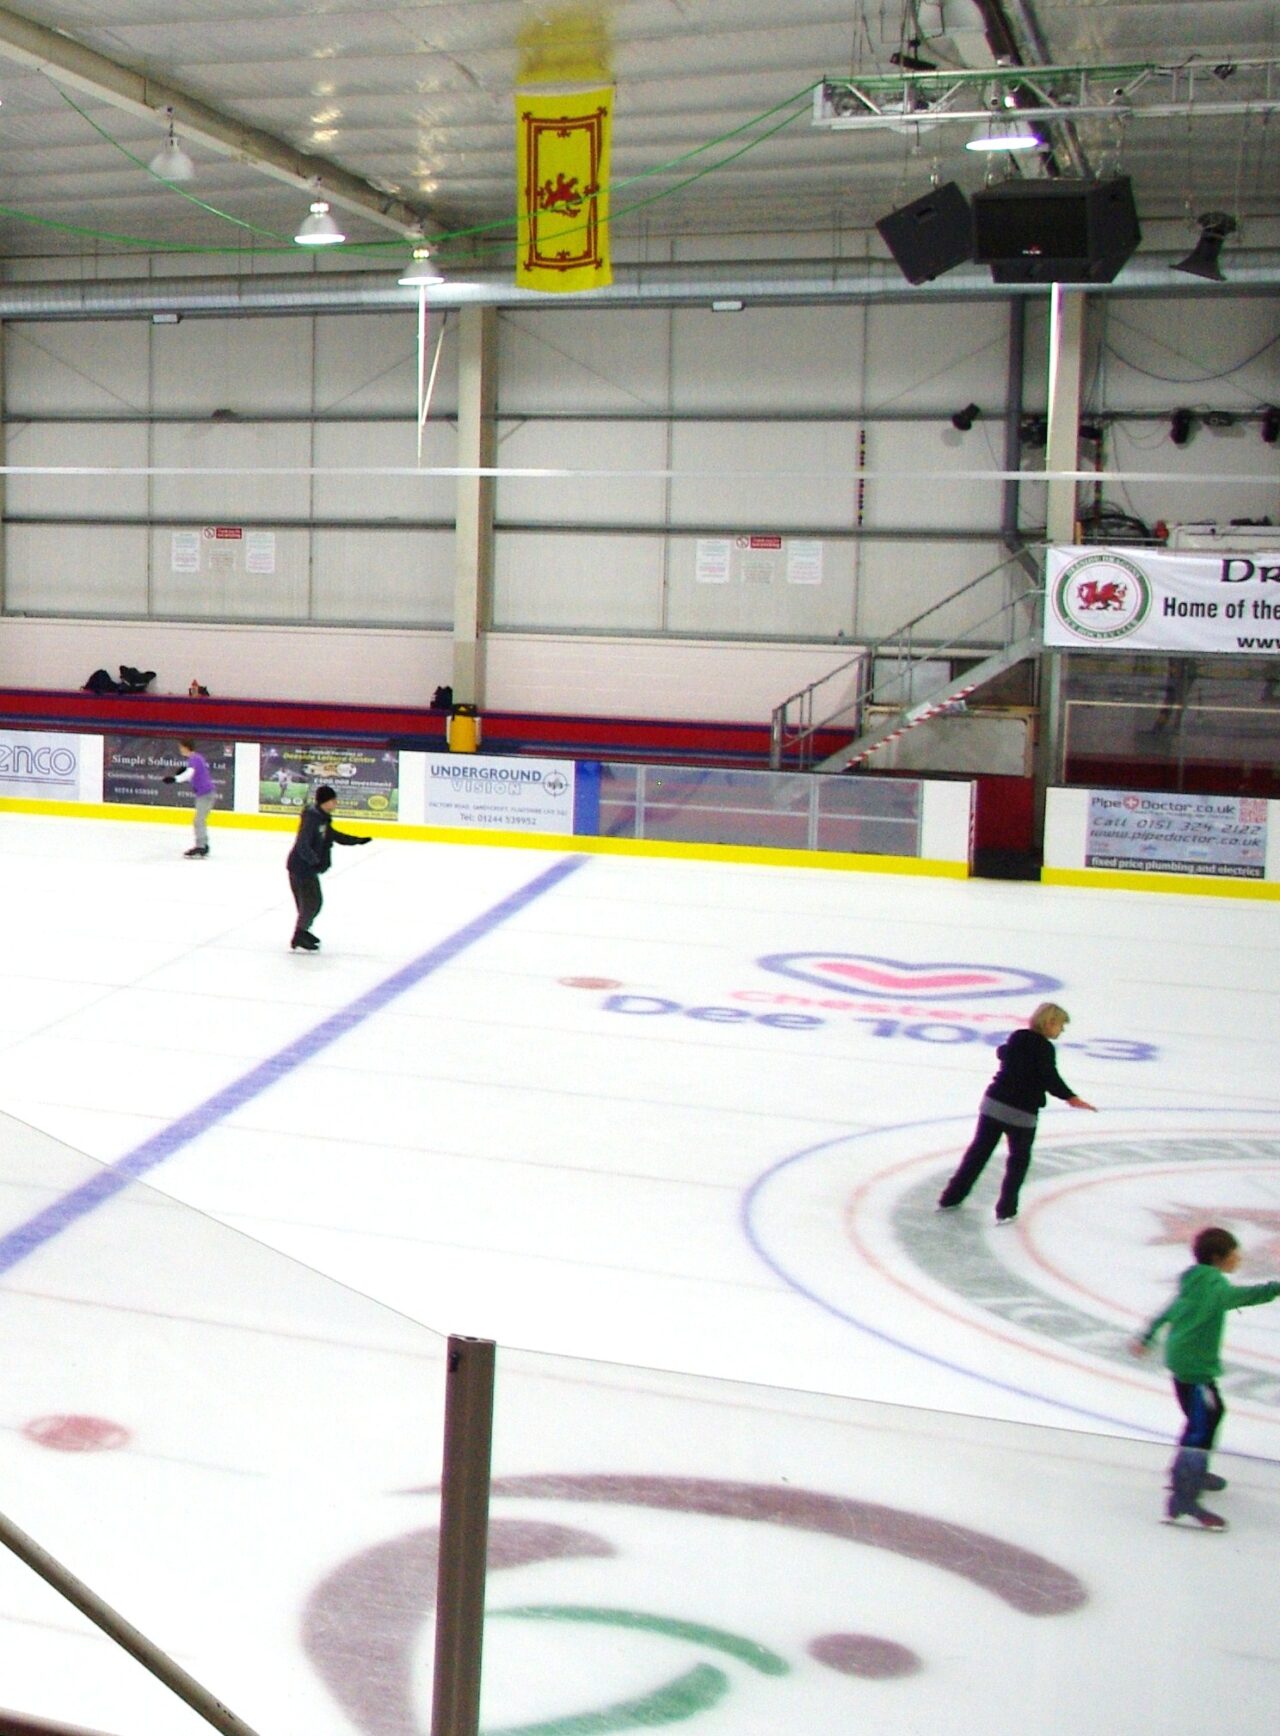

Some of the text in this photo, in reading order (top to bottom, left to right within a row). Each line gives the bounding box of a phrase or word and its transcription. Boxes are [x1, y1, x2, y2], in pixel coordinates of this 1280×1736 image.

[1163, 597, 1218, 619] Home
[1225, 599, 1246, 619] of
[111, 754, 146, 767] Simple
[430, 765, 542, 782] UNDERGROUND
[452, 779, 522, 795] VISION
[1091, 796, 1235, 814] Pipe Doctor.co.uk
[460, 812, 475, 822] Tel:
[477, 813, 503, 823] 01244
[1092, 816, 1128, 827] Call
[1136, 818, 1173, 829] 0151
[1221, 823, 1262, 836] 2122
[1089, 828, 1262, 847] www.pipedoctor.co.uk
[1091, 856, 1261, 877] fixed price plumbing and electrics
[601, 994, 825, 1030] Dee
